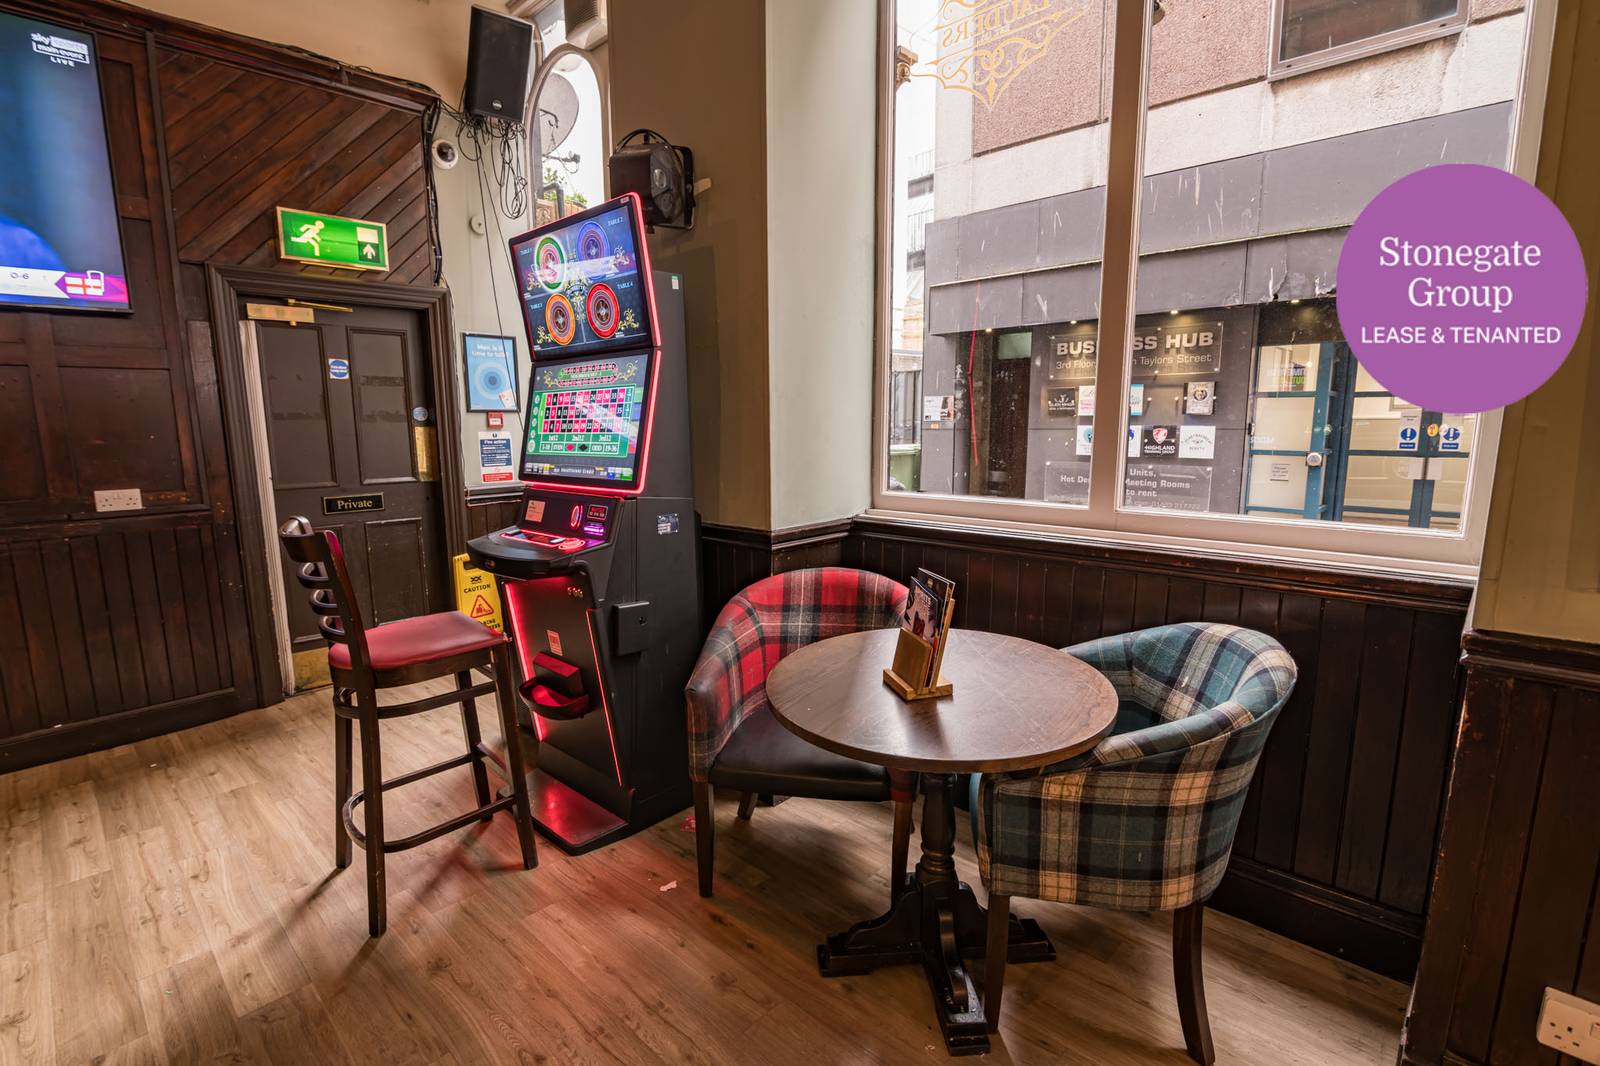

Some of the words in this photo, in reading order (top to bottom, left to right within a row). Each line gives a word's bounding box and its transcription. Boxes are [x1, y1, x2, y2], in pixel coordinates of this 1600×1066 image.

[50, 56, 75, 67] LIVE
[1165, 332, 1214, 349] HUB
[1056, 359, 1071, 370] 3rd
[1139, 356, 1173, 366] Taylors
[1176, 353, 1212, 364] Street
[1060, 474, 1075, 483] Hot
[1129, 468, 1157, 478] Units,
[1160, 480, 1191, 489] Rooms
[1126, 488, 1136, 496] to
[1137, 489, 1157, 497] rent
[337, 498, 373, 511] Private
[463, 583, 492, 594] CAUTION
